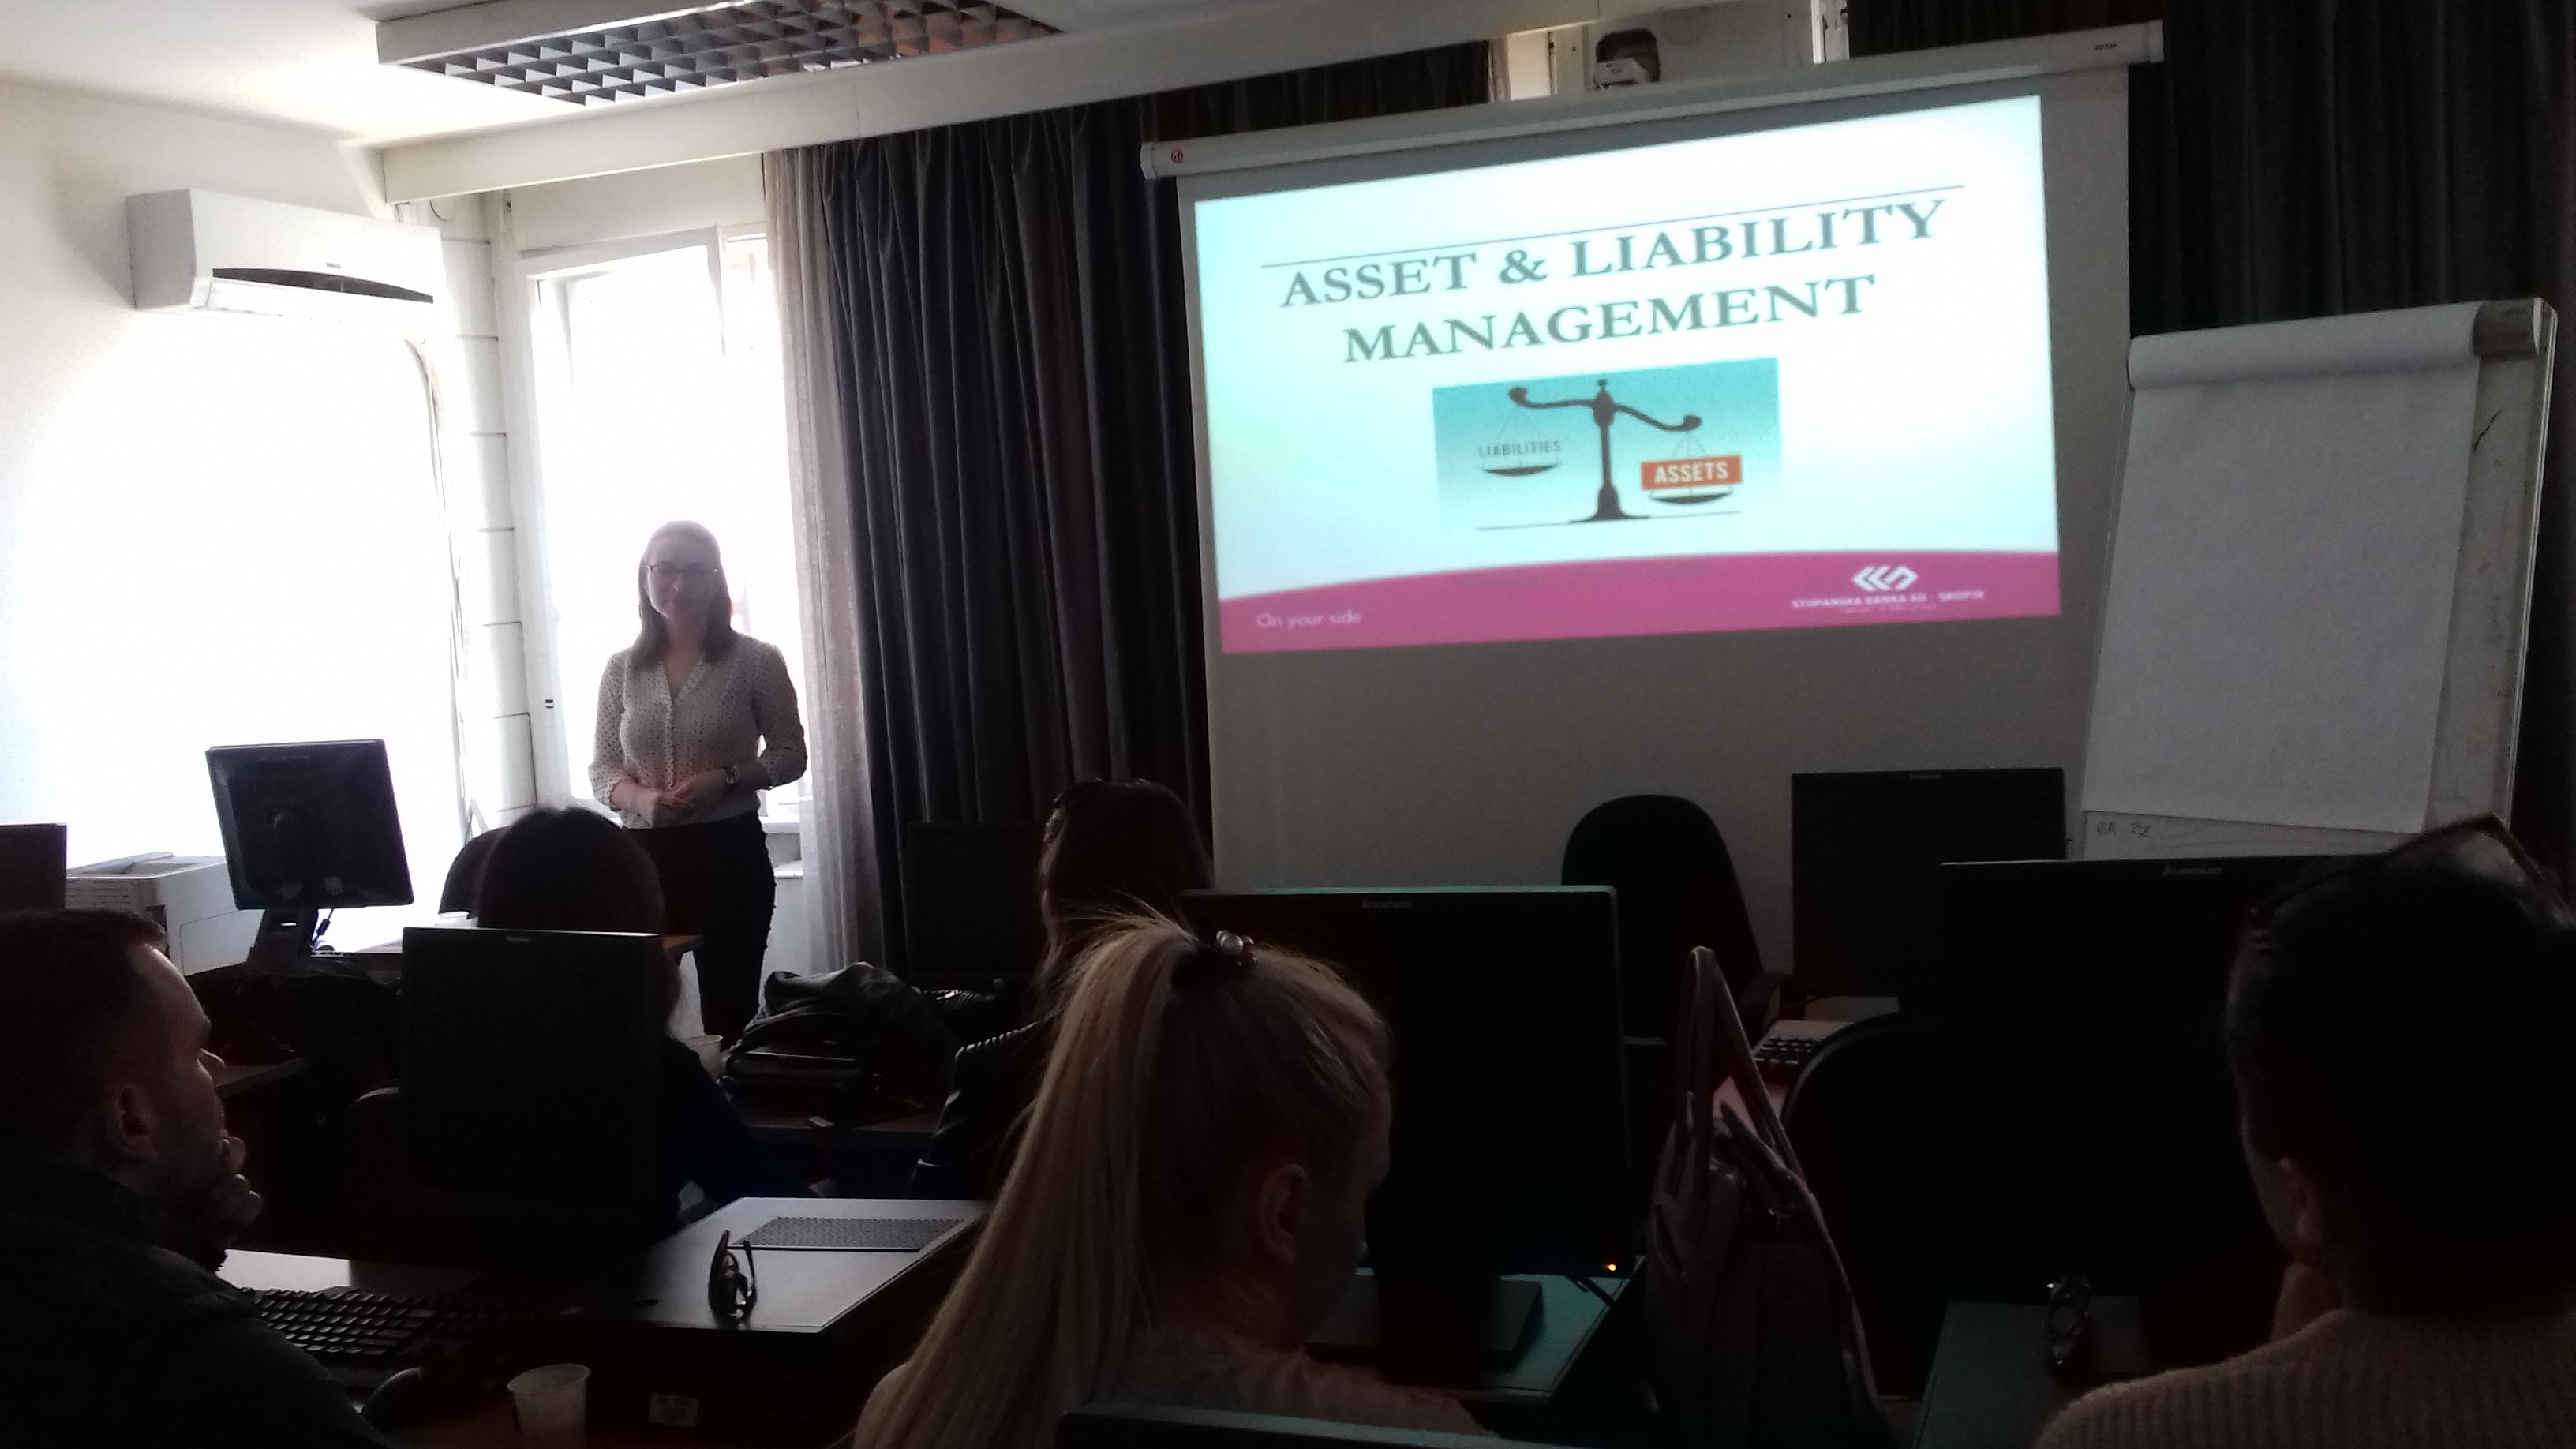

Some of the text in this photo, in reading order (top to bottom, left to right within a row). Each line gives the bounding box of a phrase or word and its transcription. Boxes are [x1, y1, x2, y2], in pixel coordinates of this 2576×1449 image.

[1280, 200, 1944, 308] ASSET & LIABILITY
[1342, 274, 1876, 364] MANAGEMENT
[1477, 439, 1562, 459] LIABILITIES
[1654, 460, 1728, 485] ASSETS
[1256, 609, 1361, 631] On your side
